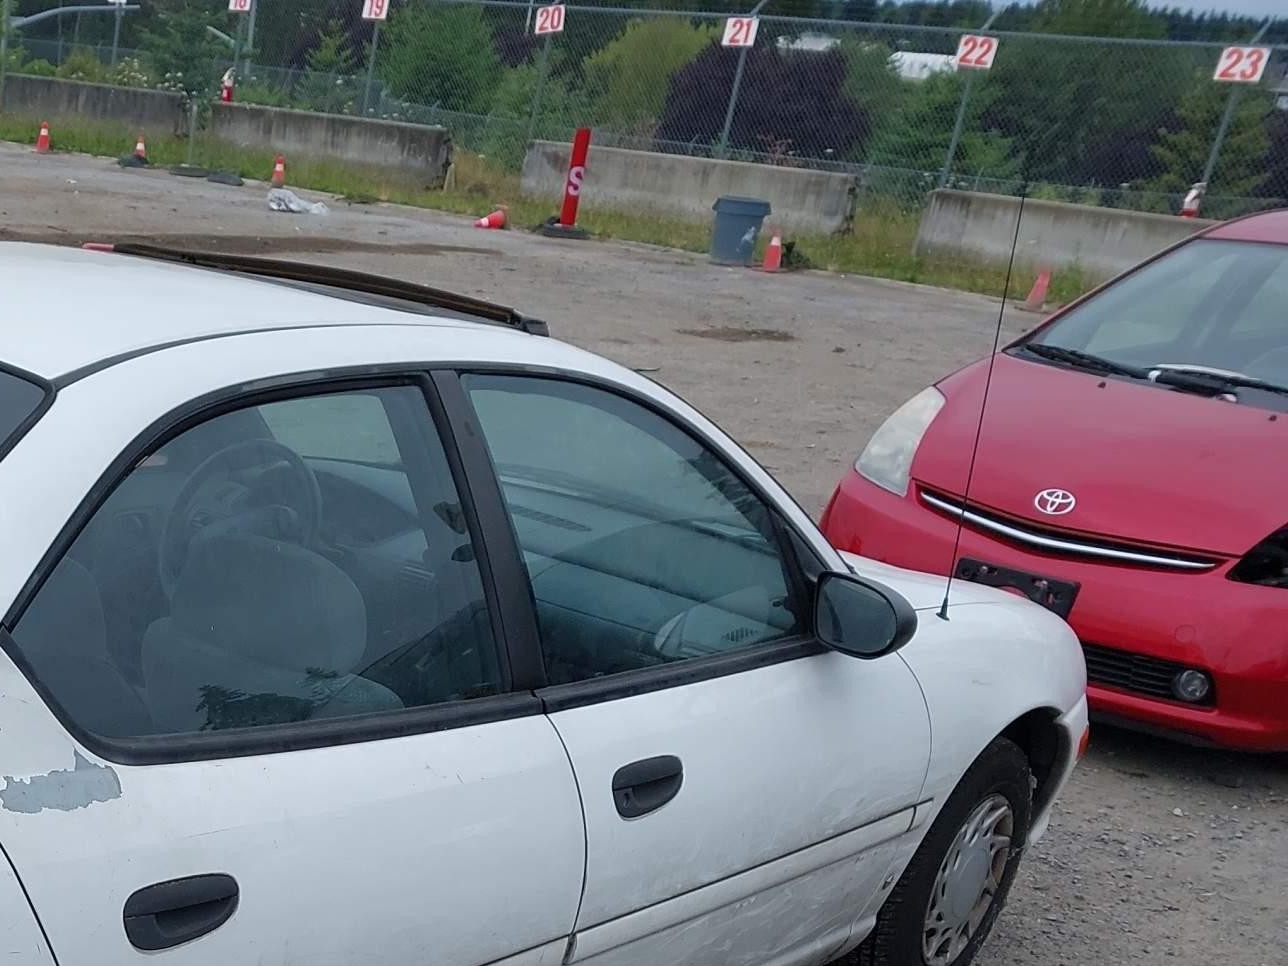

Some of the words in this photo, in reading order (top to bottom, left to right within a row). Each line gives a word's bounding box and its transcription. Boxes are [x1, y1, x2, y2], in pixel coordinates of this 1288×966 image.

[367, 0, 383, 17] 19
[539, 7, 561, 31] 20
[730, 19, 752, 44] 21
[959, 37, 993, 65] 22
[1220, 48, 1264, 79] 23
